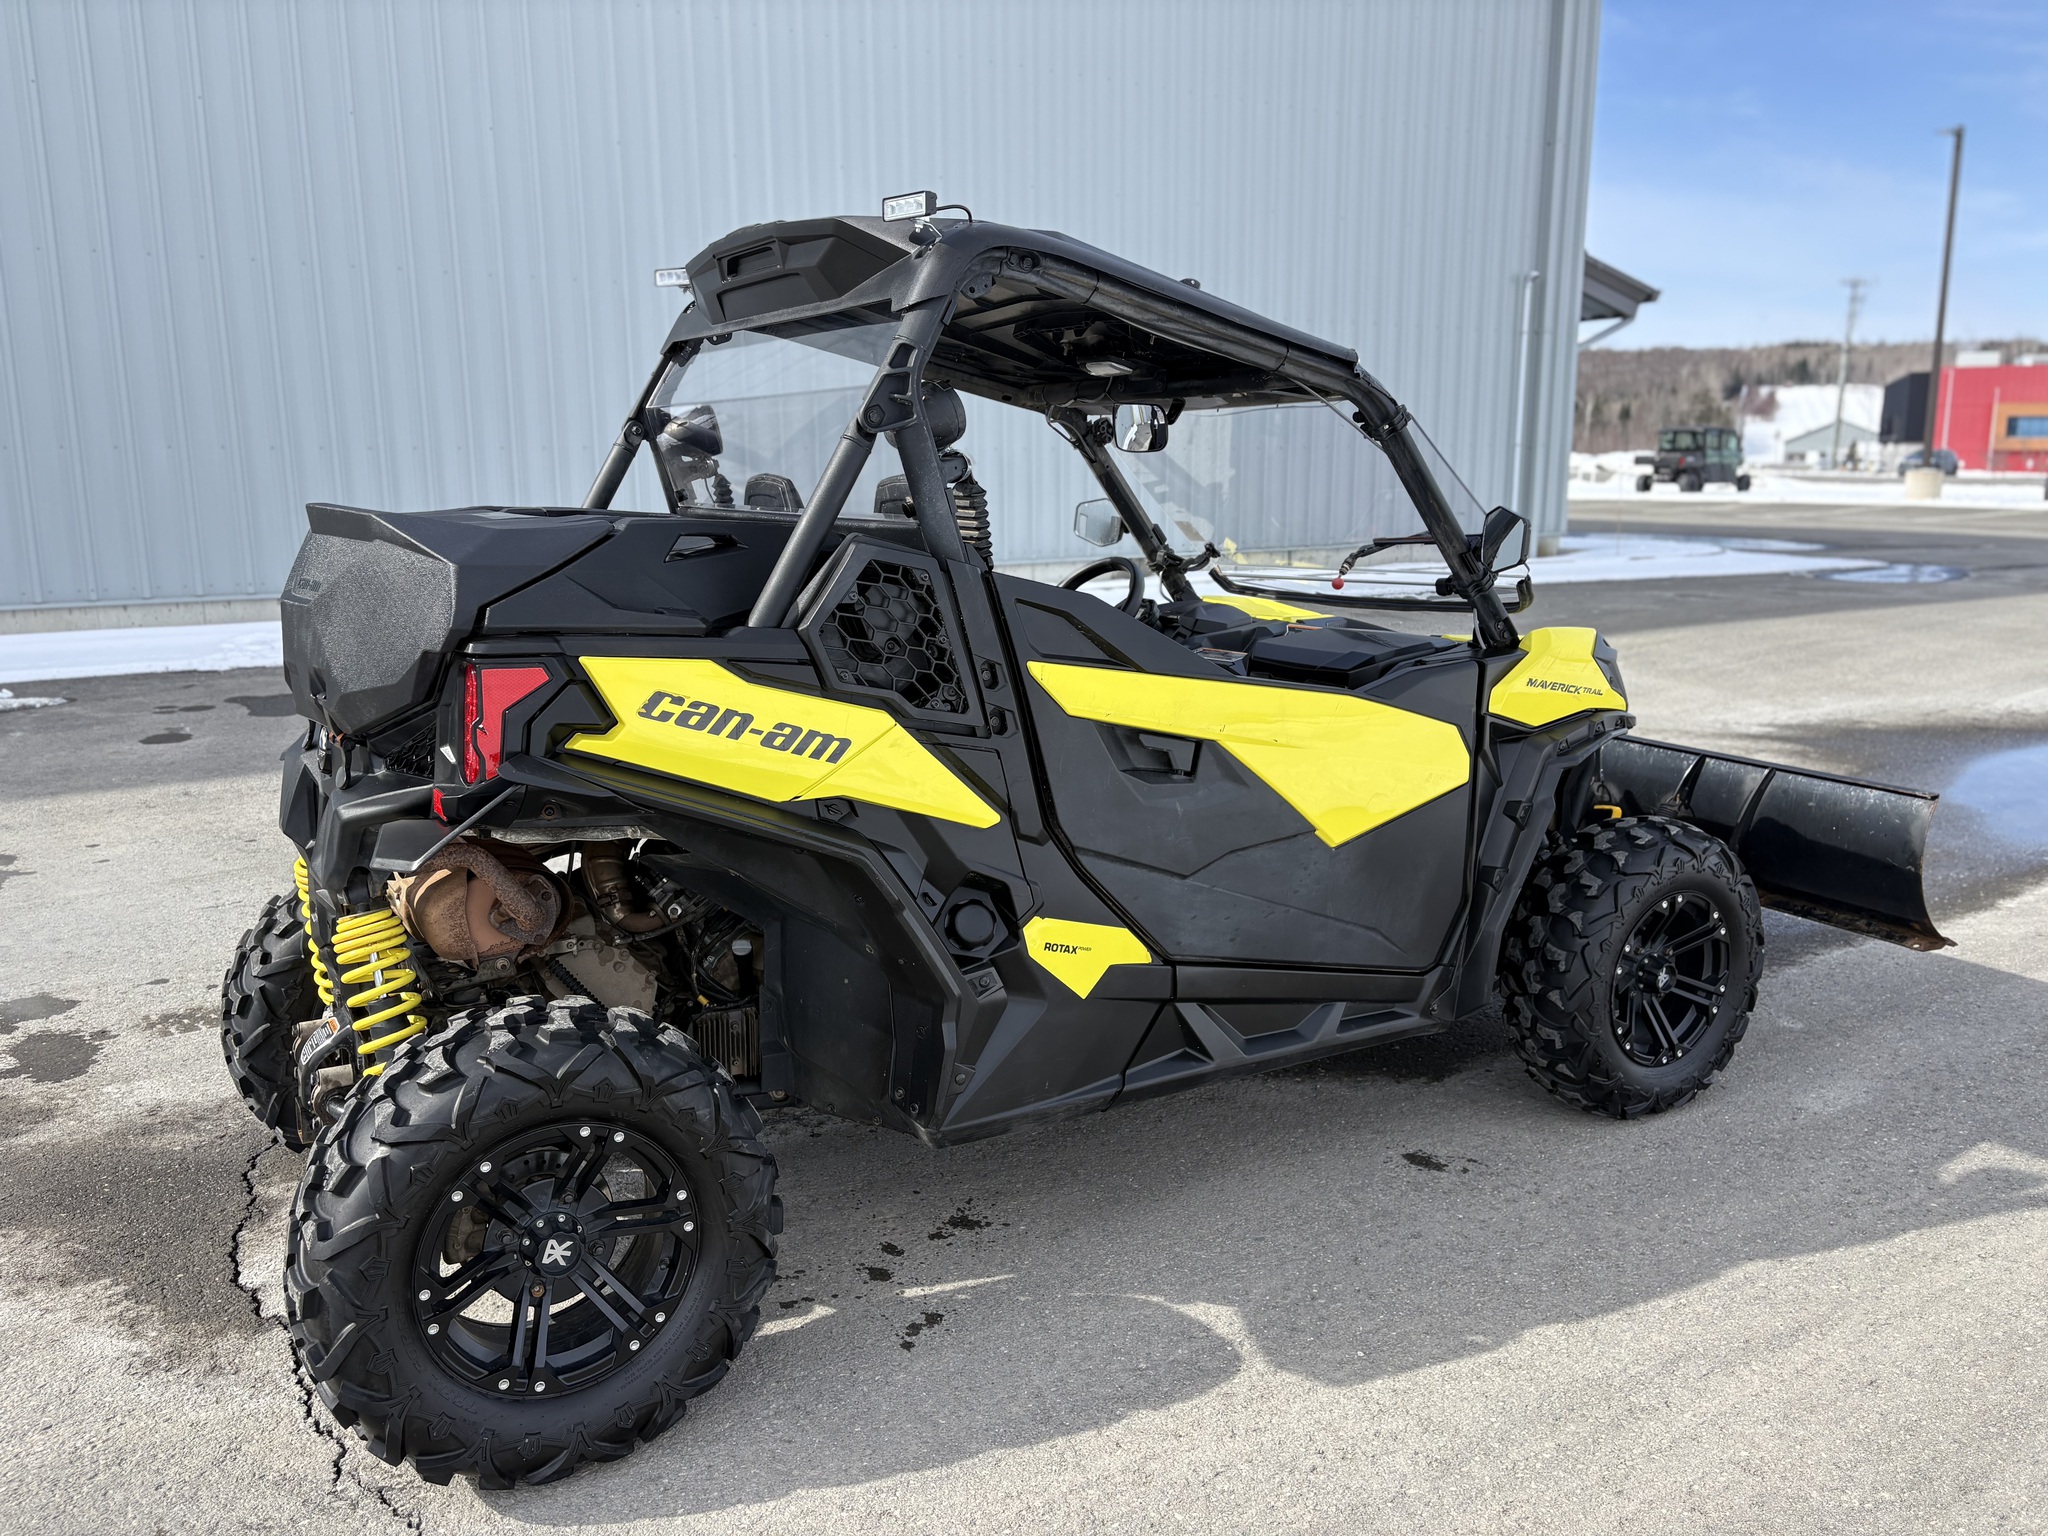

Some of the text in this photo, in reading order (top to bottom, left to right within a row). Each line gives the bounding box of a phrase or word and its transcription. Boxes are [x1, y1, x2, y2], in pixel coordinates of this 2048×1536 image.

[1526, 677, 1604, 696] MAVERICK TRAIL
[1043, 942, 1078, 955] ROTAX
